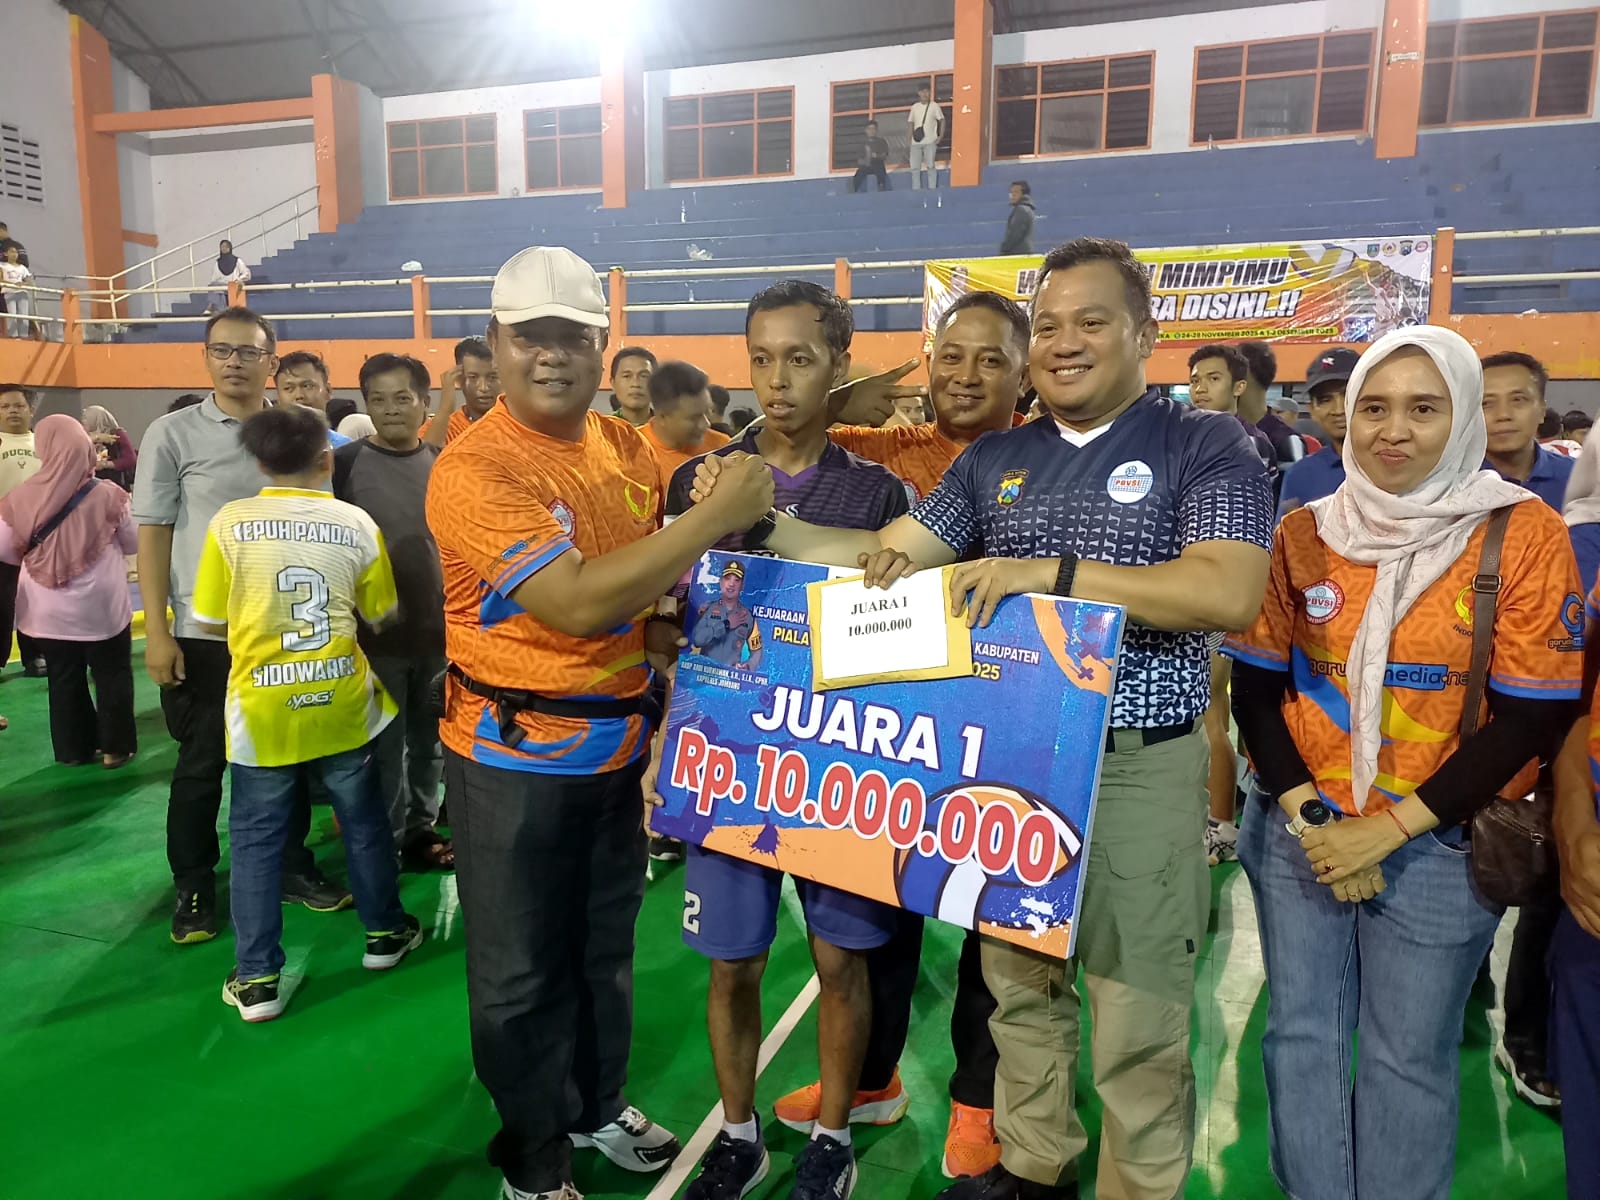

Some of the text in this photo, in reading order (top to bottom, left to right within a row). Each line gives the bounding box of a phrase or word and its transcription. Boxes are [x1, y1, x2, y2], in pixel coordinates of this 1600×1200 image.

[1158, 259, 1291, 290] MIMPIMU
[277, 565, 330, 652] 3
[850, 598, 900, 616] JUARA
[1306, 597, 1333, 607] PBVSI
[752, 605, 1040, 665] KEJUARAAN KABUPATEN
[848, 617, 912, 637] 10.000.000
[251, 655, 356, 688] SIDOWAREK
[772, 626, 810, 646] PIALA
[972, 661, 1001, 680] 025
[752, 685, 985, 779] JUARA 1
[672, 728, 1059, 887] Rp. 10.000.000
[683, 890, 701, 935] 2
